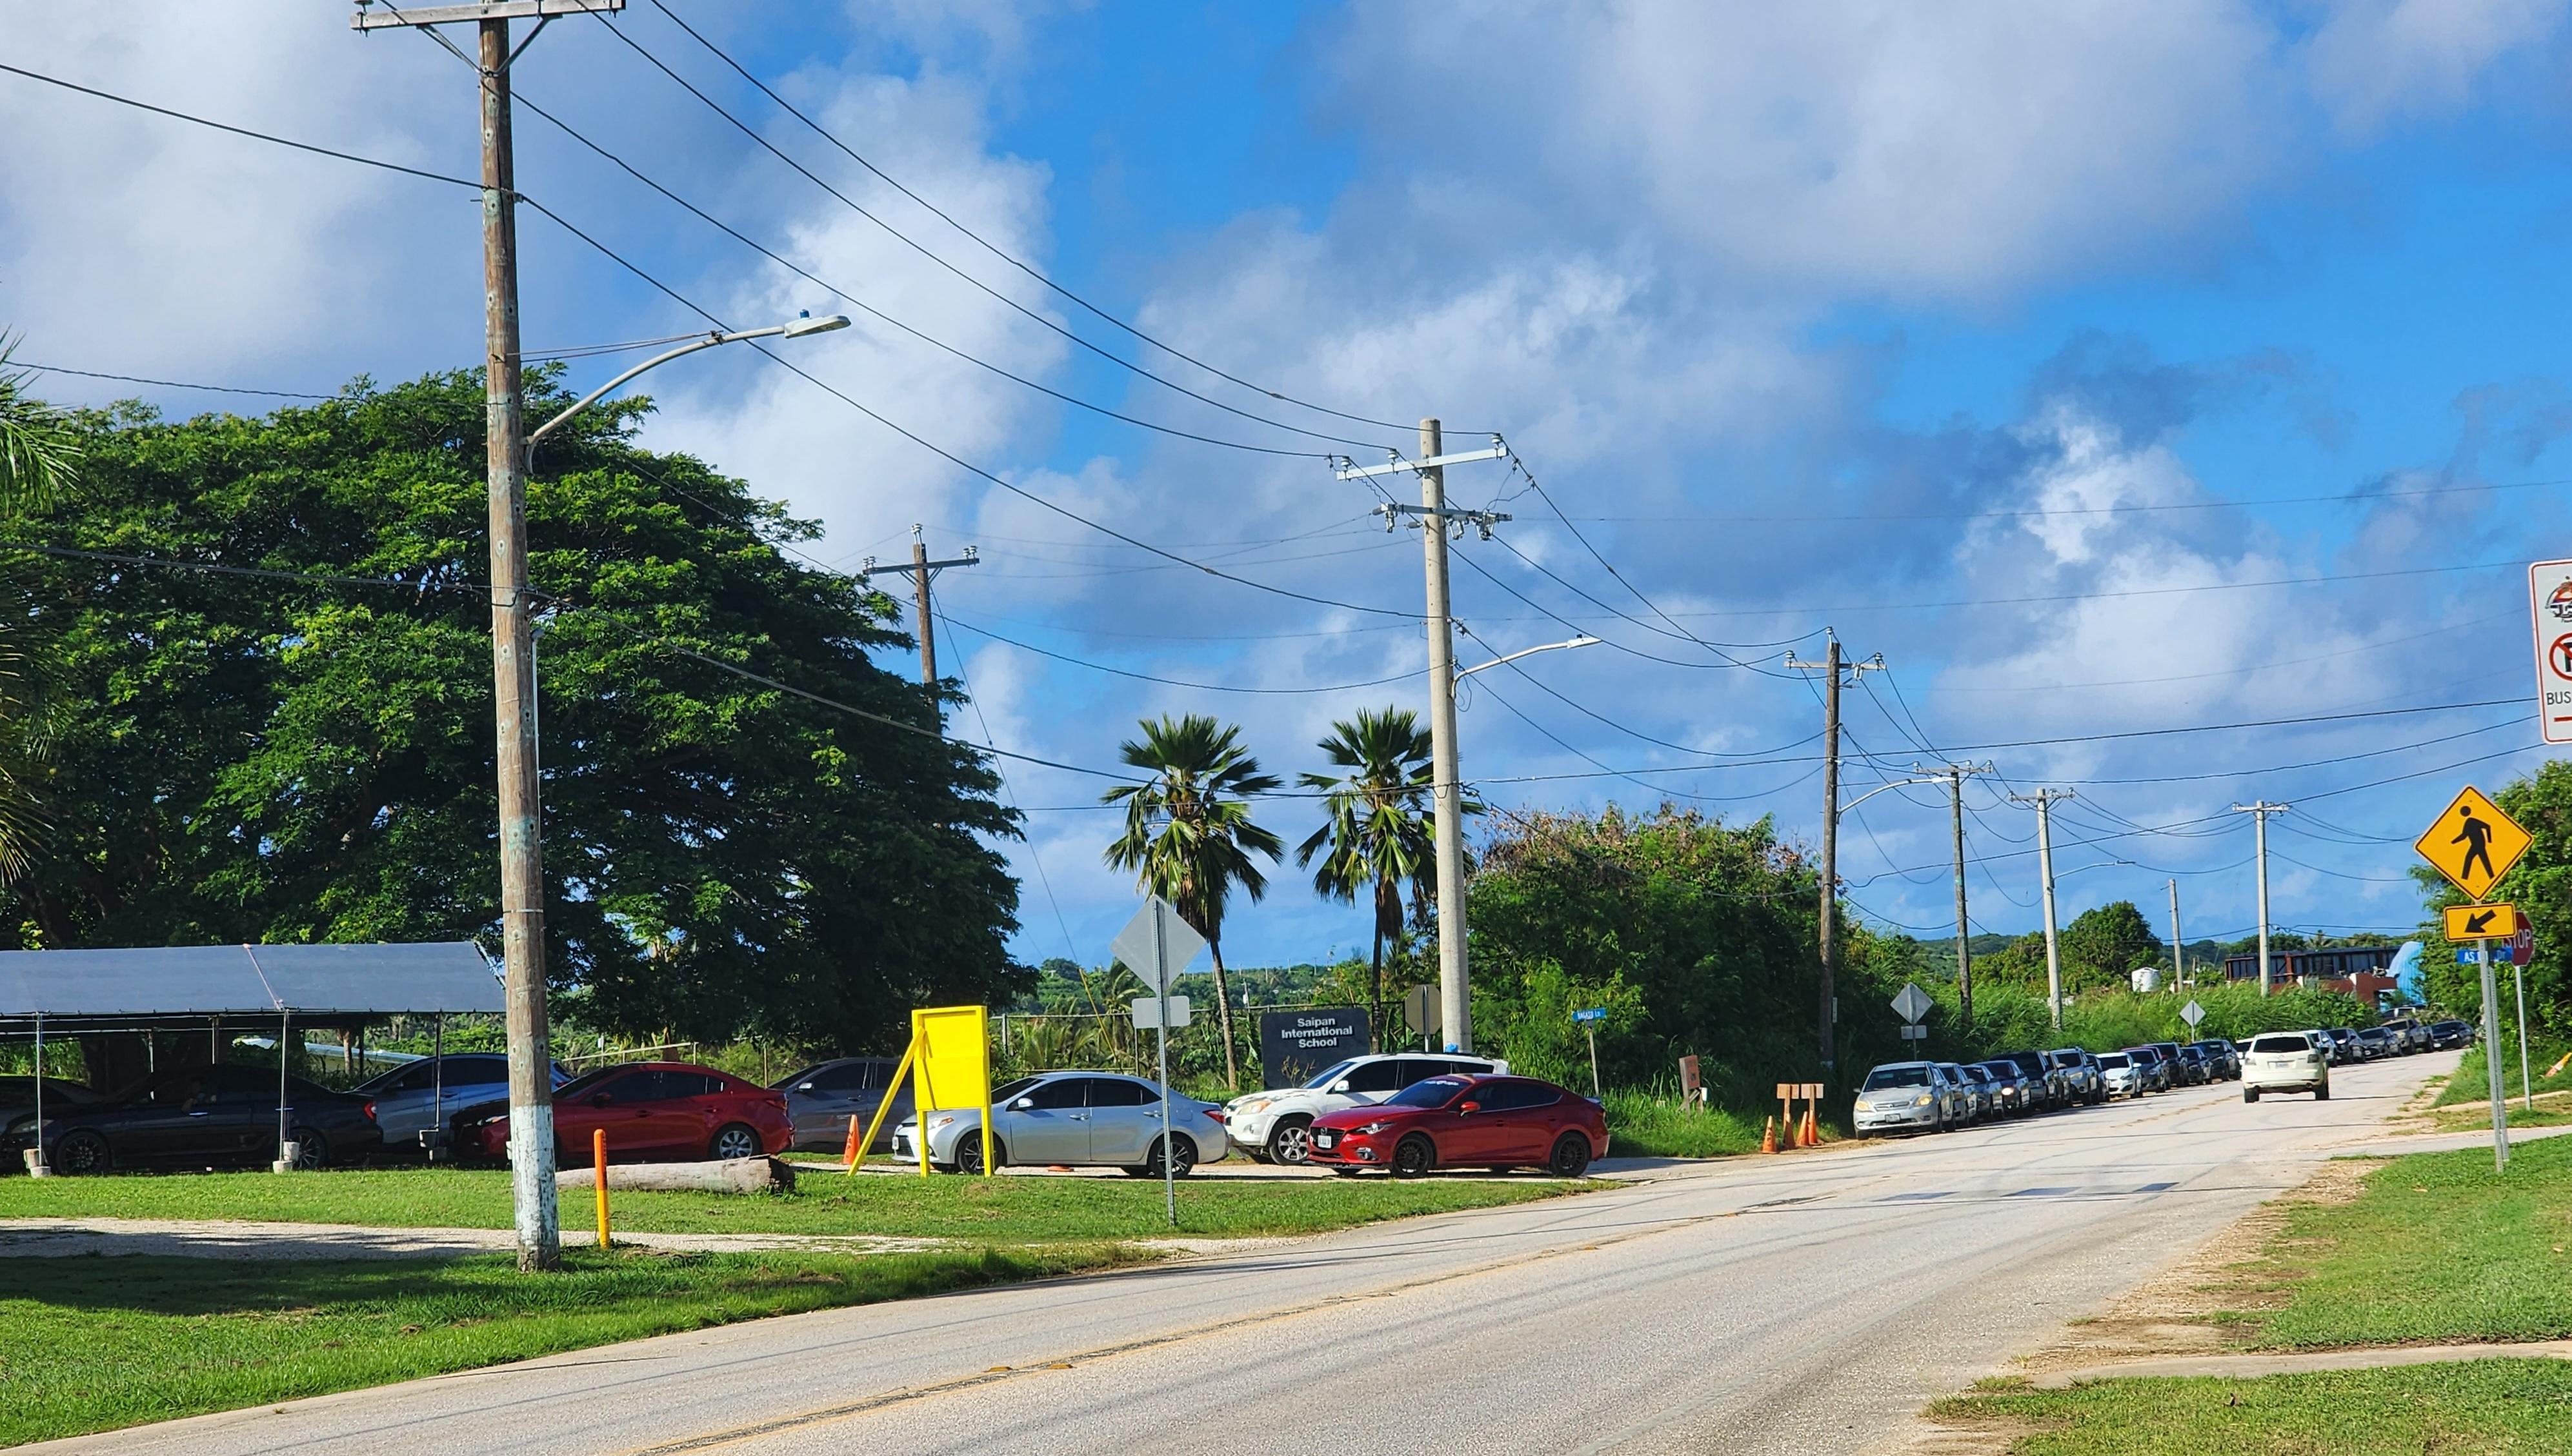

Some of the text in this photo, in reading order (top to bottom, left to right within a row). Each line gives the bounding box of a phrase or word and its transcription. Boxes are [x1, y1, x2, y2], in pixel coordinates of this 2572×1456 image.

[1297, 1017, 1336, 1028] Saipan
[1281, 1026, 1353, 1039] International
[1298, 1037, 1338, 1048] School
